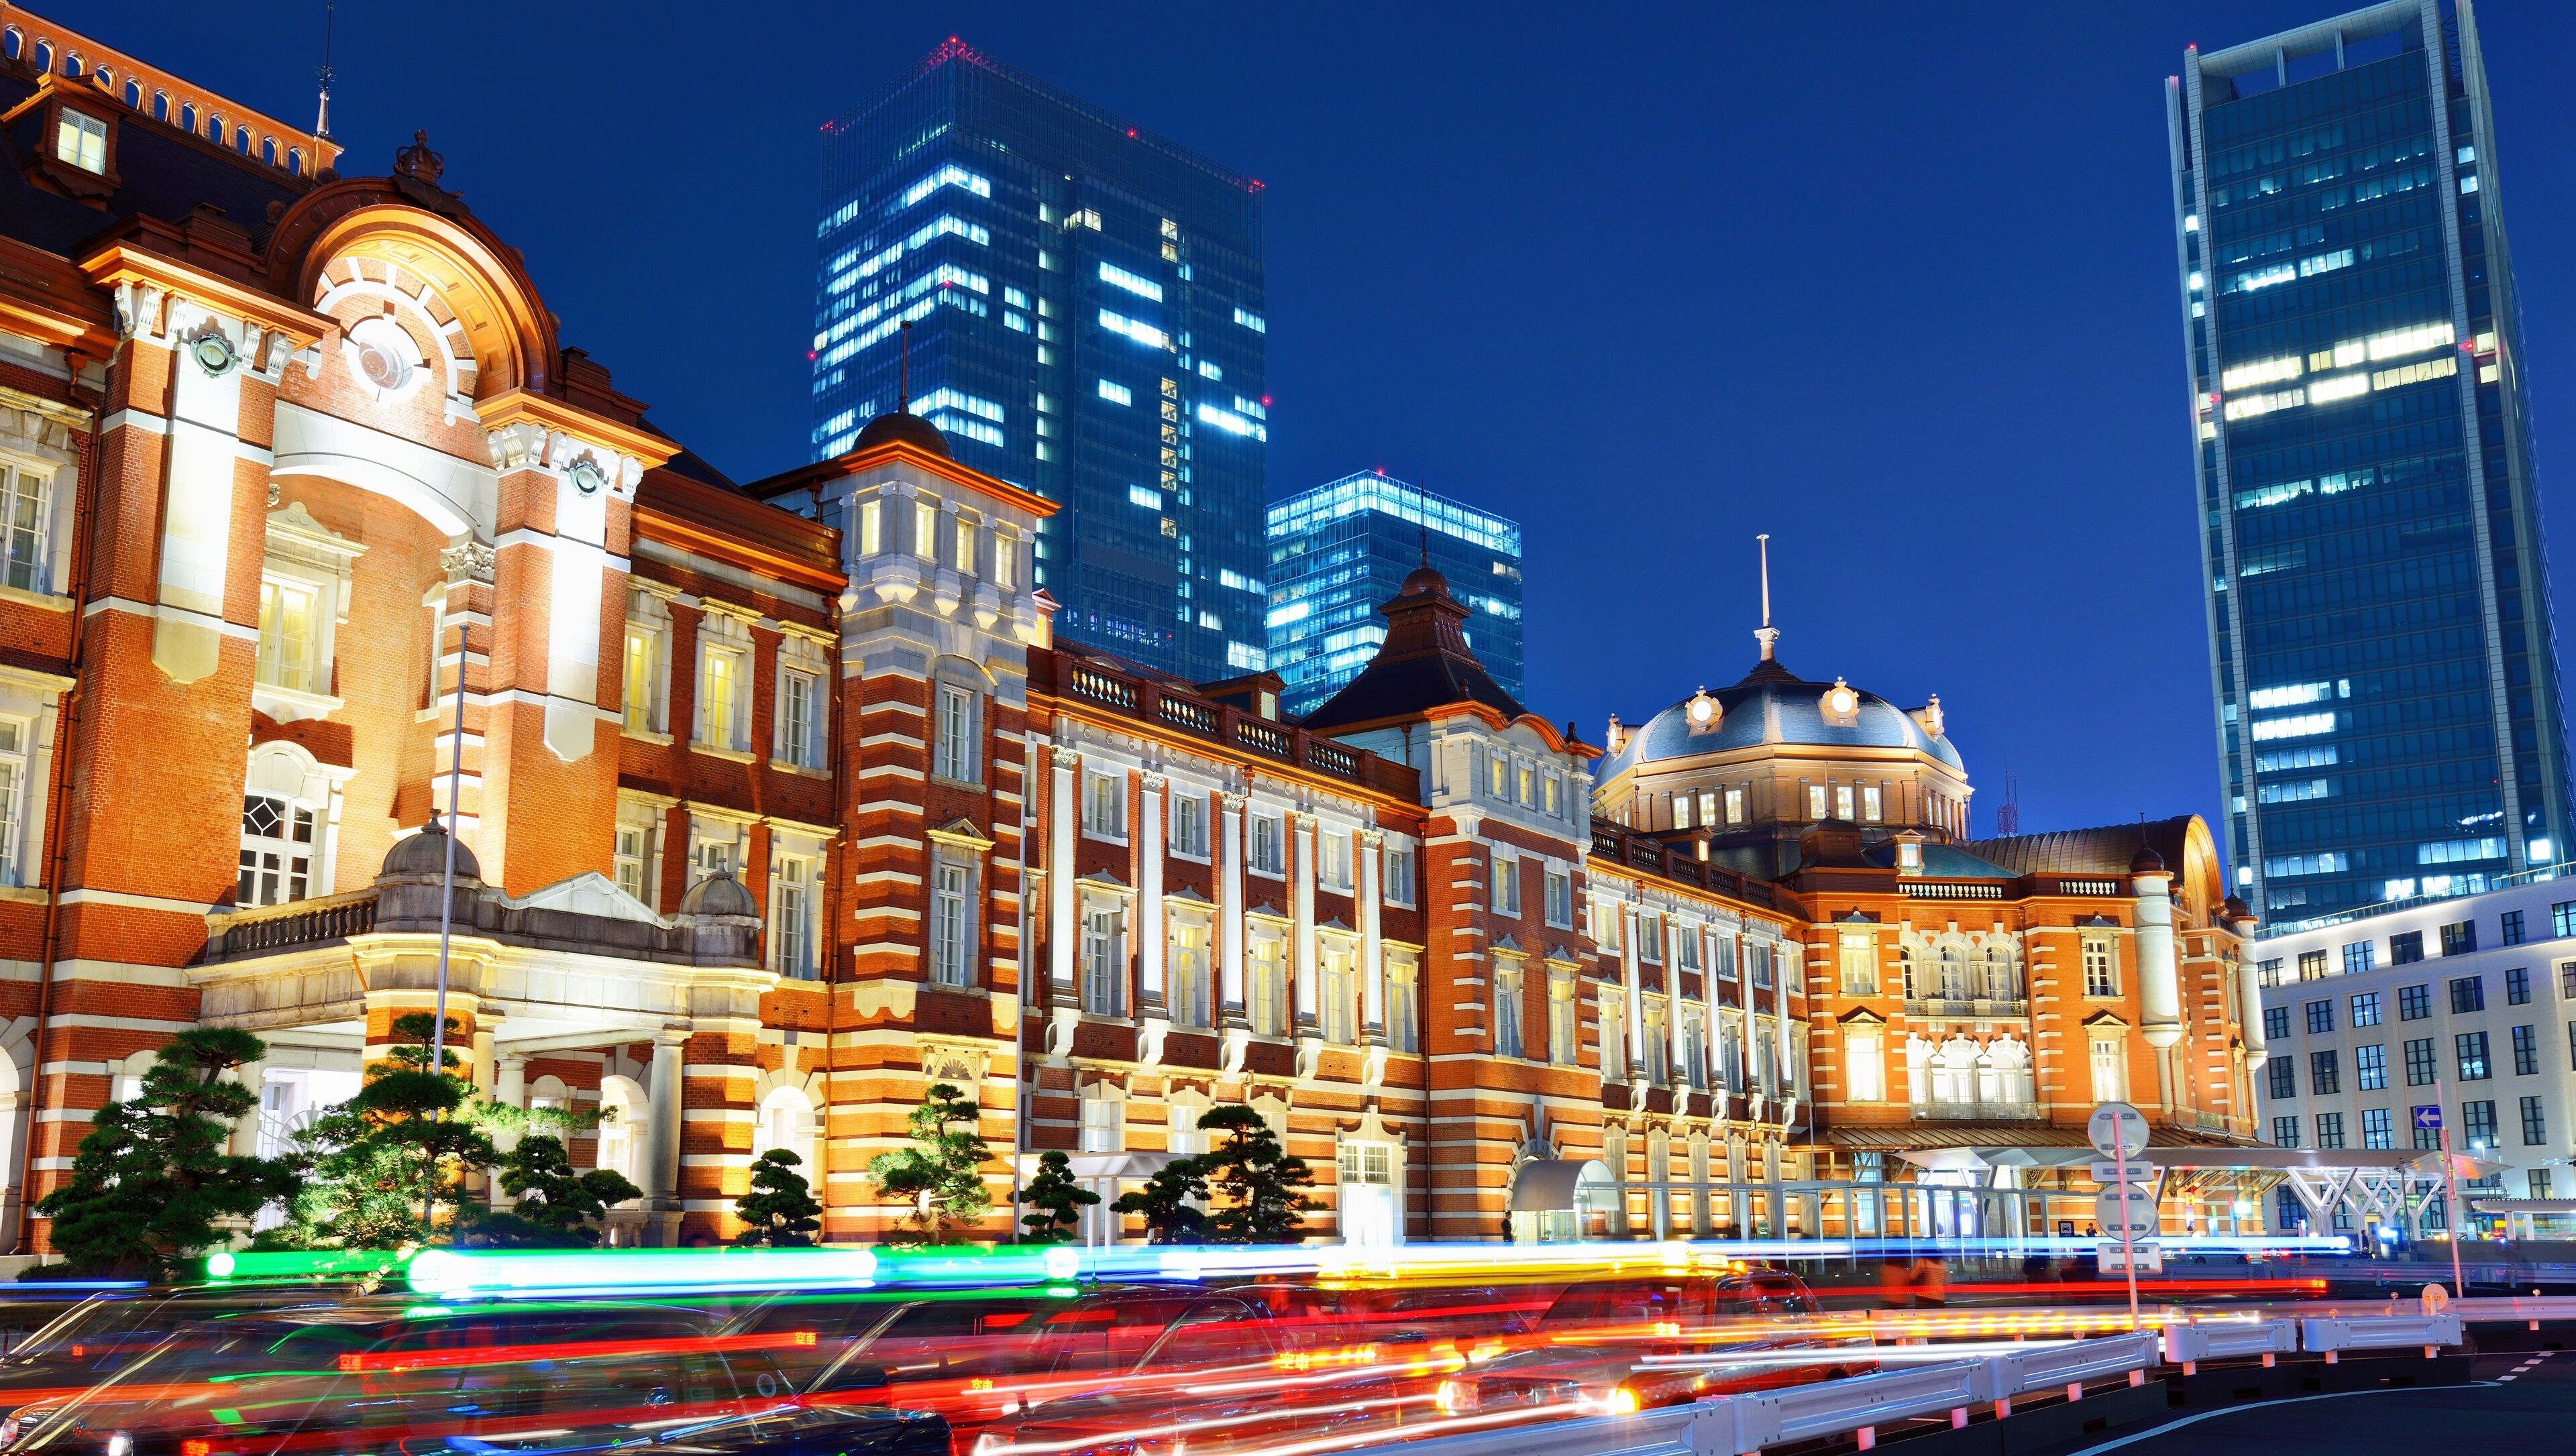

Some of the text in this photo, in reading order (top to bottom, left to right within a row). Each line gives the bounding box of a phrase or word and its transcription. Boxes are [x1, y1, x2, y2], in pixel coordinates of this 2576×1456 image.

[795, 1332, 816, 1345] 空車
[339, 1354, 361, 1371] 空車
[1280, 1352, 1309, 1370] 空車
[971, 1378, 993, 1393] 空車
